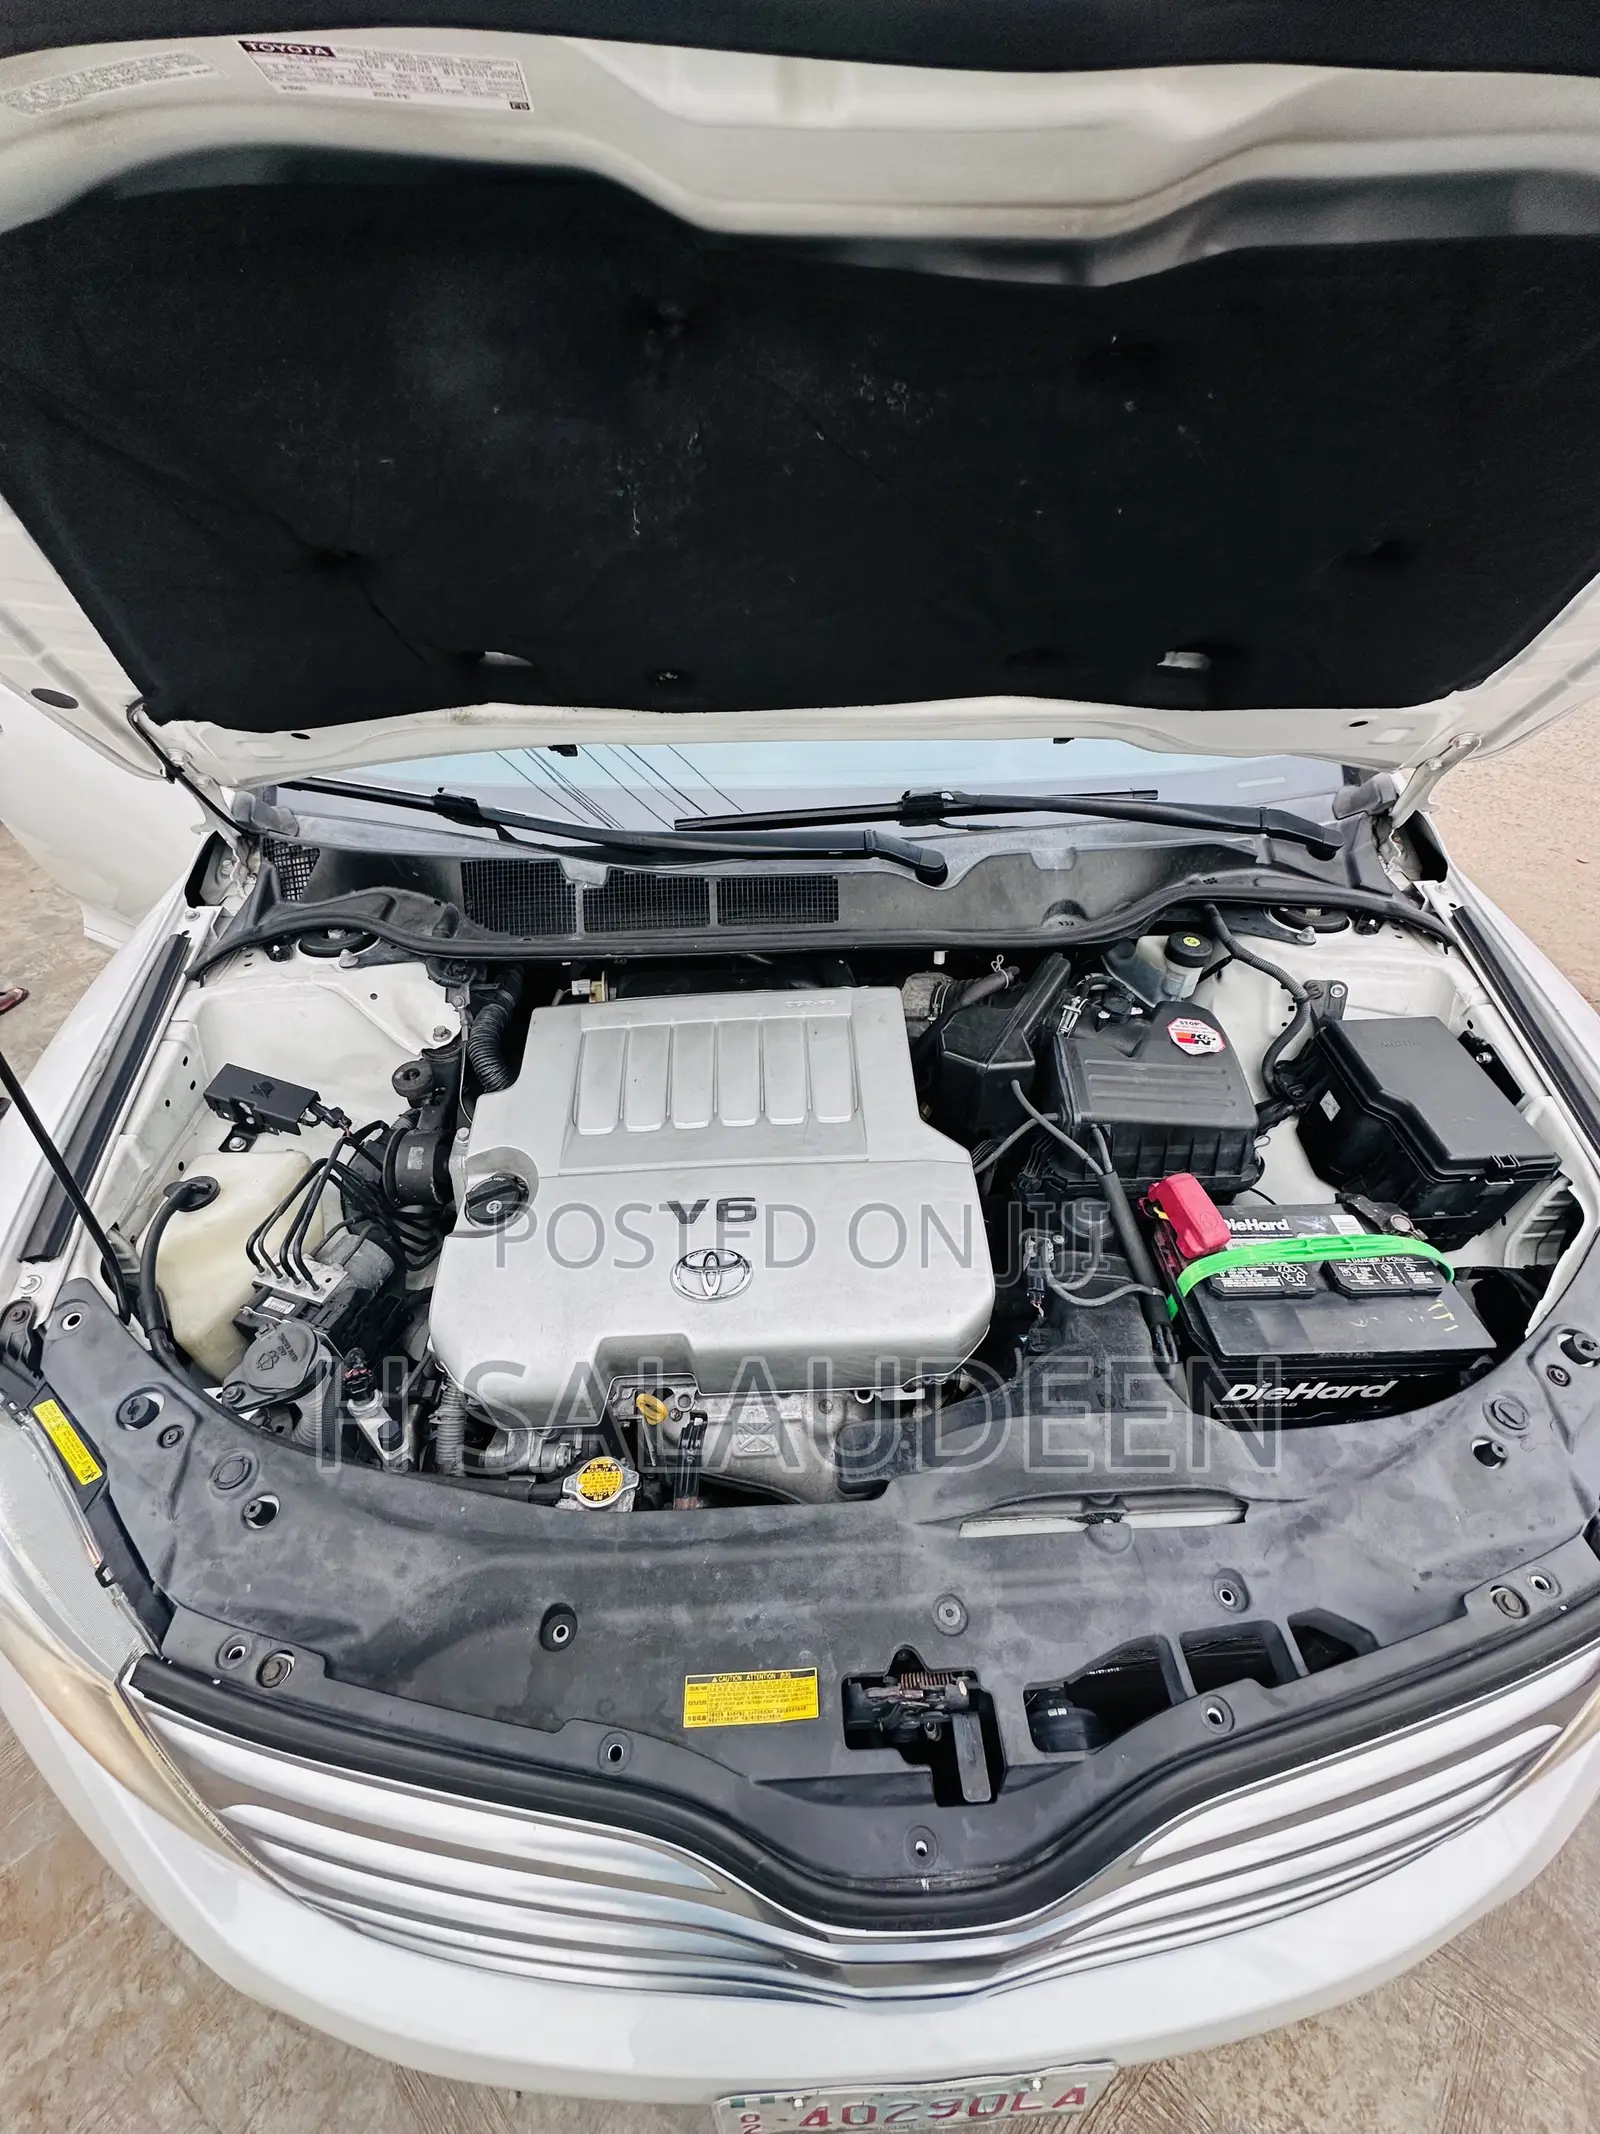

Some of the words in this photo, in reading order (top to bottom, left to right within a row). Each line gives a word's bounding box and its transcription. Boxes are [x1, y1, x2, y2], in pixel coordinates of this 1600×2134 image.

[244, 42, 330, 56] TOYOTA
[1221, 1380, 1399, 1402] DieHard
[718, 1675, 743, 1683] CAUTION
[746, 1672, 777, 1681] ATTENTION
